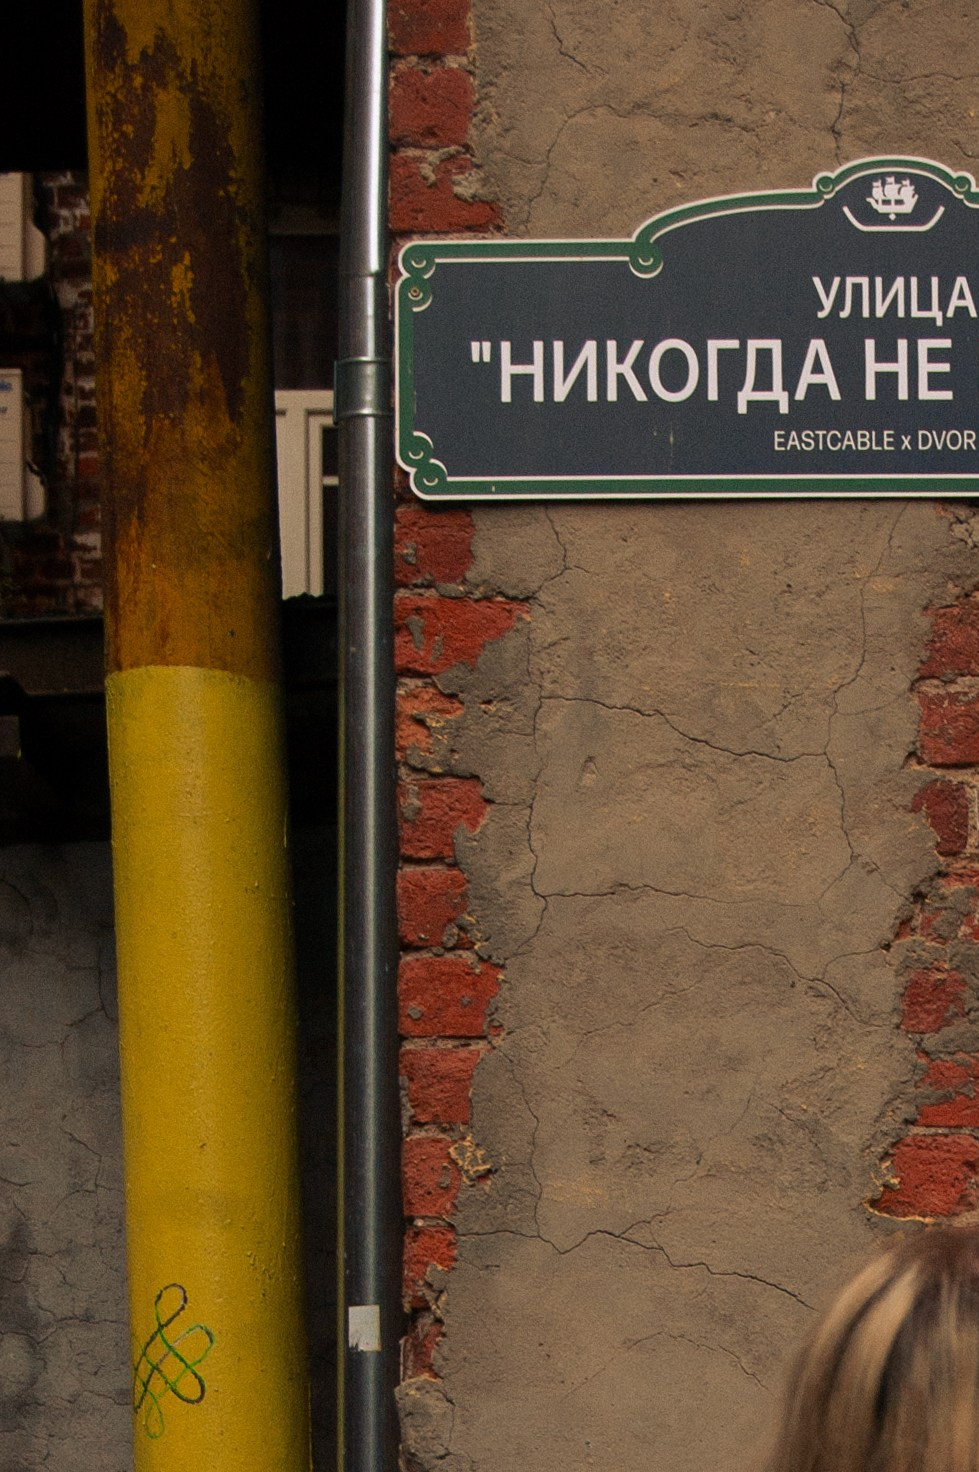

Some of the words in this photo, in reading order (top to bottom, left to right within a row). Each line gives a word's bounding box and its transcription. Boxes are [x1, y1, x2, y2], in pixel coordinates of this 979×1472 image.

[812, 276, 977, 325] УЛИЦА
[470, 338, 842, 415] "НИКОГДА
[864, 338, 954, 401] НЕ
[774, 429, 895, 451] EASTCABLE
[917, 429, 977, 451] DVOR
